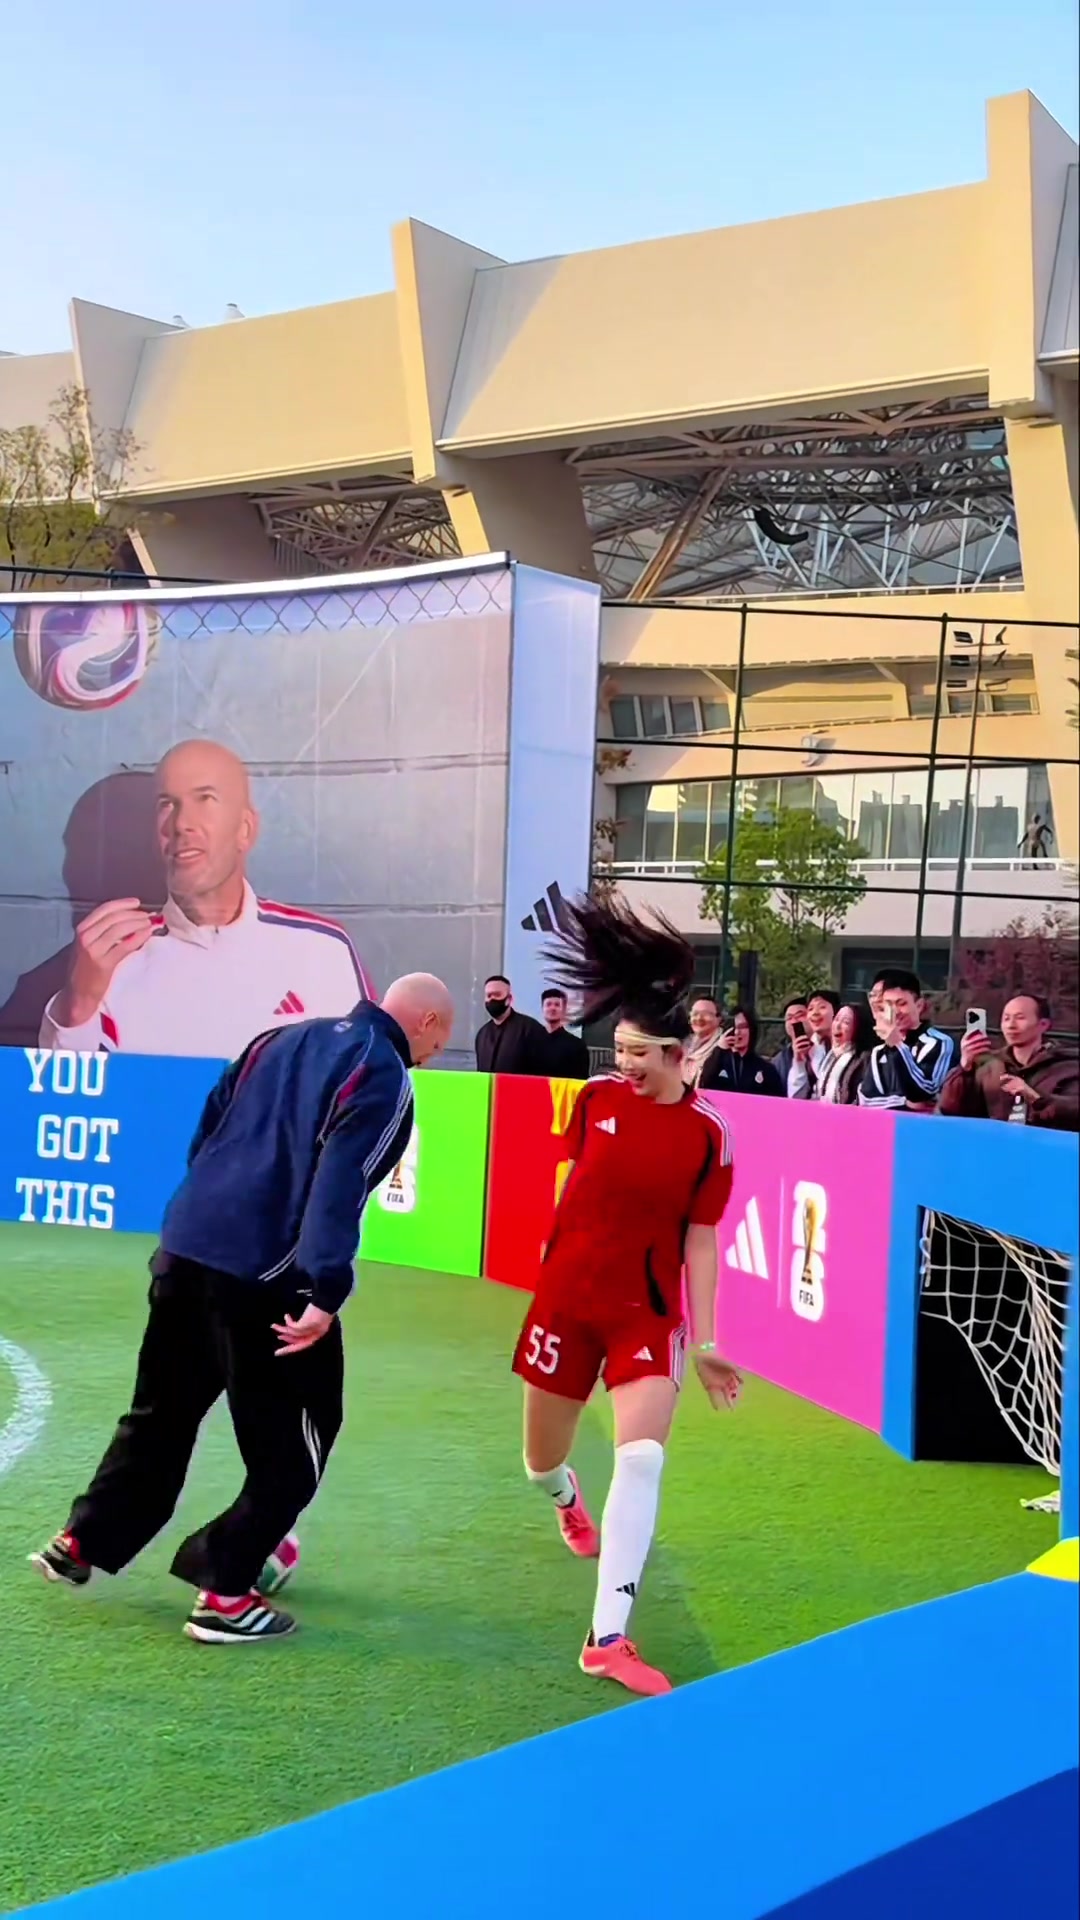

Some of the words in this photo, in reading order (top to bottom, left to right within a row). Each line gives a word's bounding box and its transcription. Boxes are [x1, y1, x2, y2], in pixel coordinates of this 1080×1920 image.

[24, 1048, 108, 1096] YOU
[37, 1114, 119, 1163] GOT
[16, 1177, 115, 1229] THIS
[525, 1324, 561, 1374] 55
